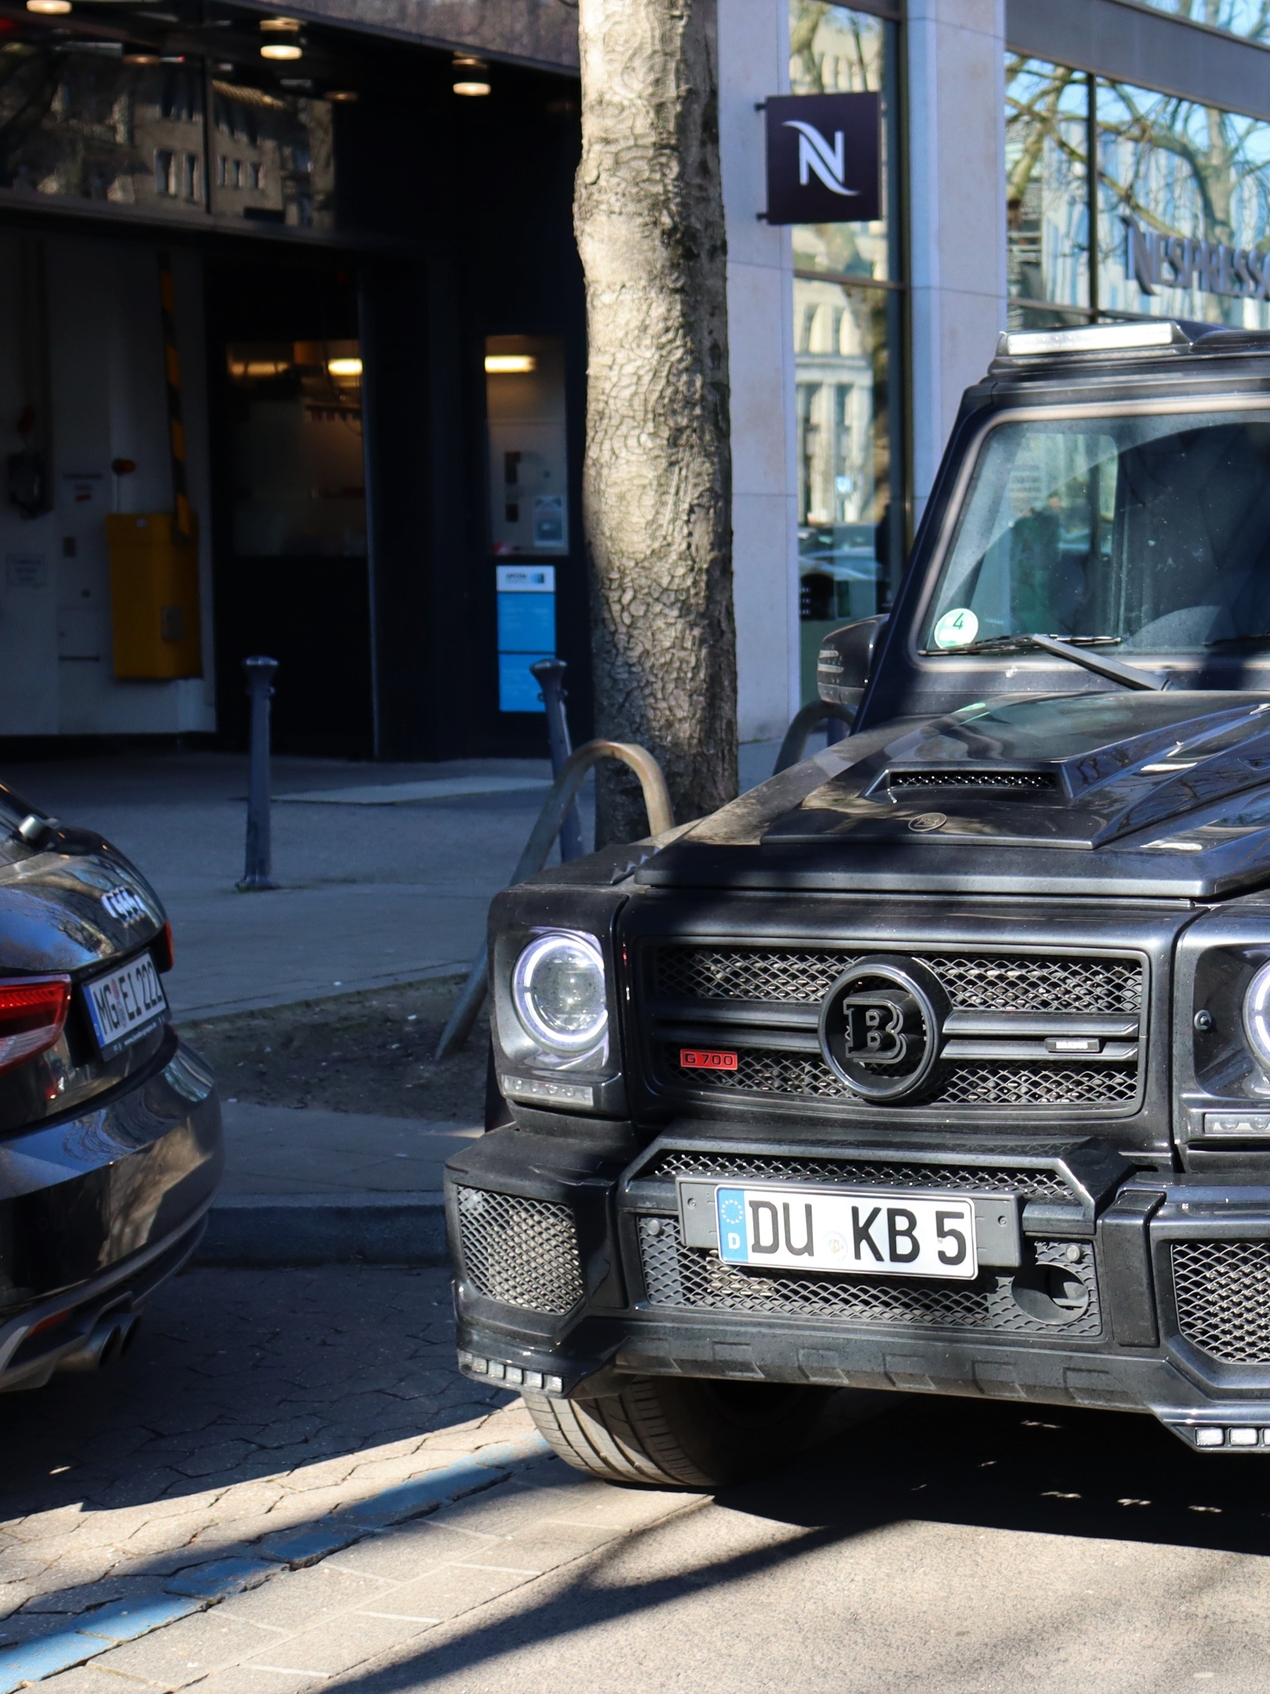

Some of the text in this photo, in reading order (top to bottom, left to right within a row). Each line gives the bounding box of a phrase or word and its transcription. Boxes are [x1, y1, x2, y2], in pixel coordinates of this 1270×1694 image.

[781, 120, 860, 196] N
[952, 612, 964, 630] 4
[93, 983, 121, 1035] MG
[135, 960, 163, 1012] 222
[684, 1053, 733, 1067] G 700
[728, 1199, 968, 1266] D DU KB 5
